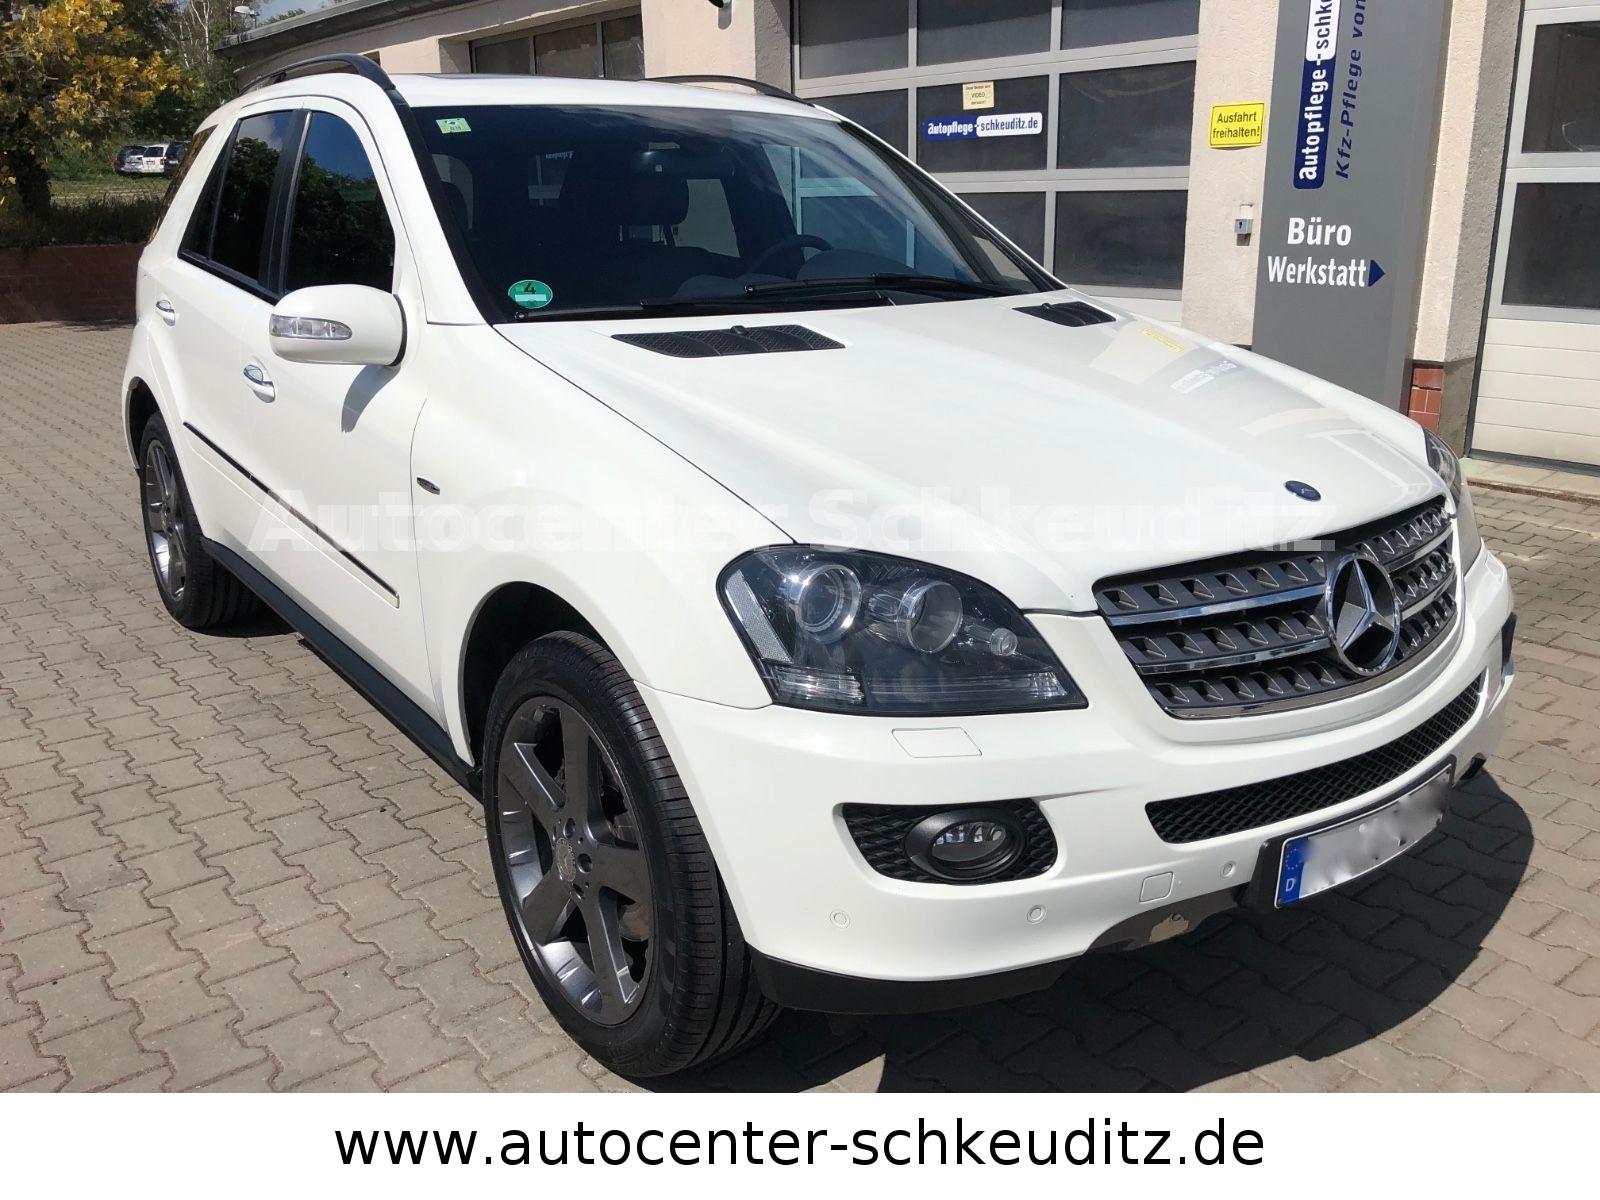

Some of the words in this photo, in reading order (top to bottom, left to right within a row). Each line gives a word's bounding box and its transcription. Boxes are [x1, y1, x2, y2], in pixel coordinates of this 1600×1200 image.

[1299, 0, 1333, 180] autopflege-schk
[1335, 50, 1363, 179] Kfz-Pflege
[1352, 0, 1366, 38] von
[1216, 111, 1257, 123] Ausfahrt
[1212, 126, 1260, 139] freihalten!
[1287, 216, 1352, 246] Büro
[1267, 255, 1367, 288] Werkstatt
[524, 281, 537, 294] 4
[1285, 877, 1297, 892] D
